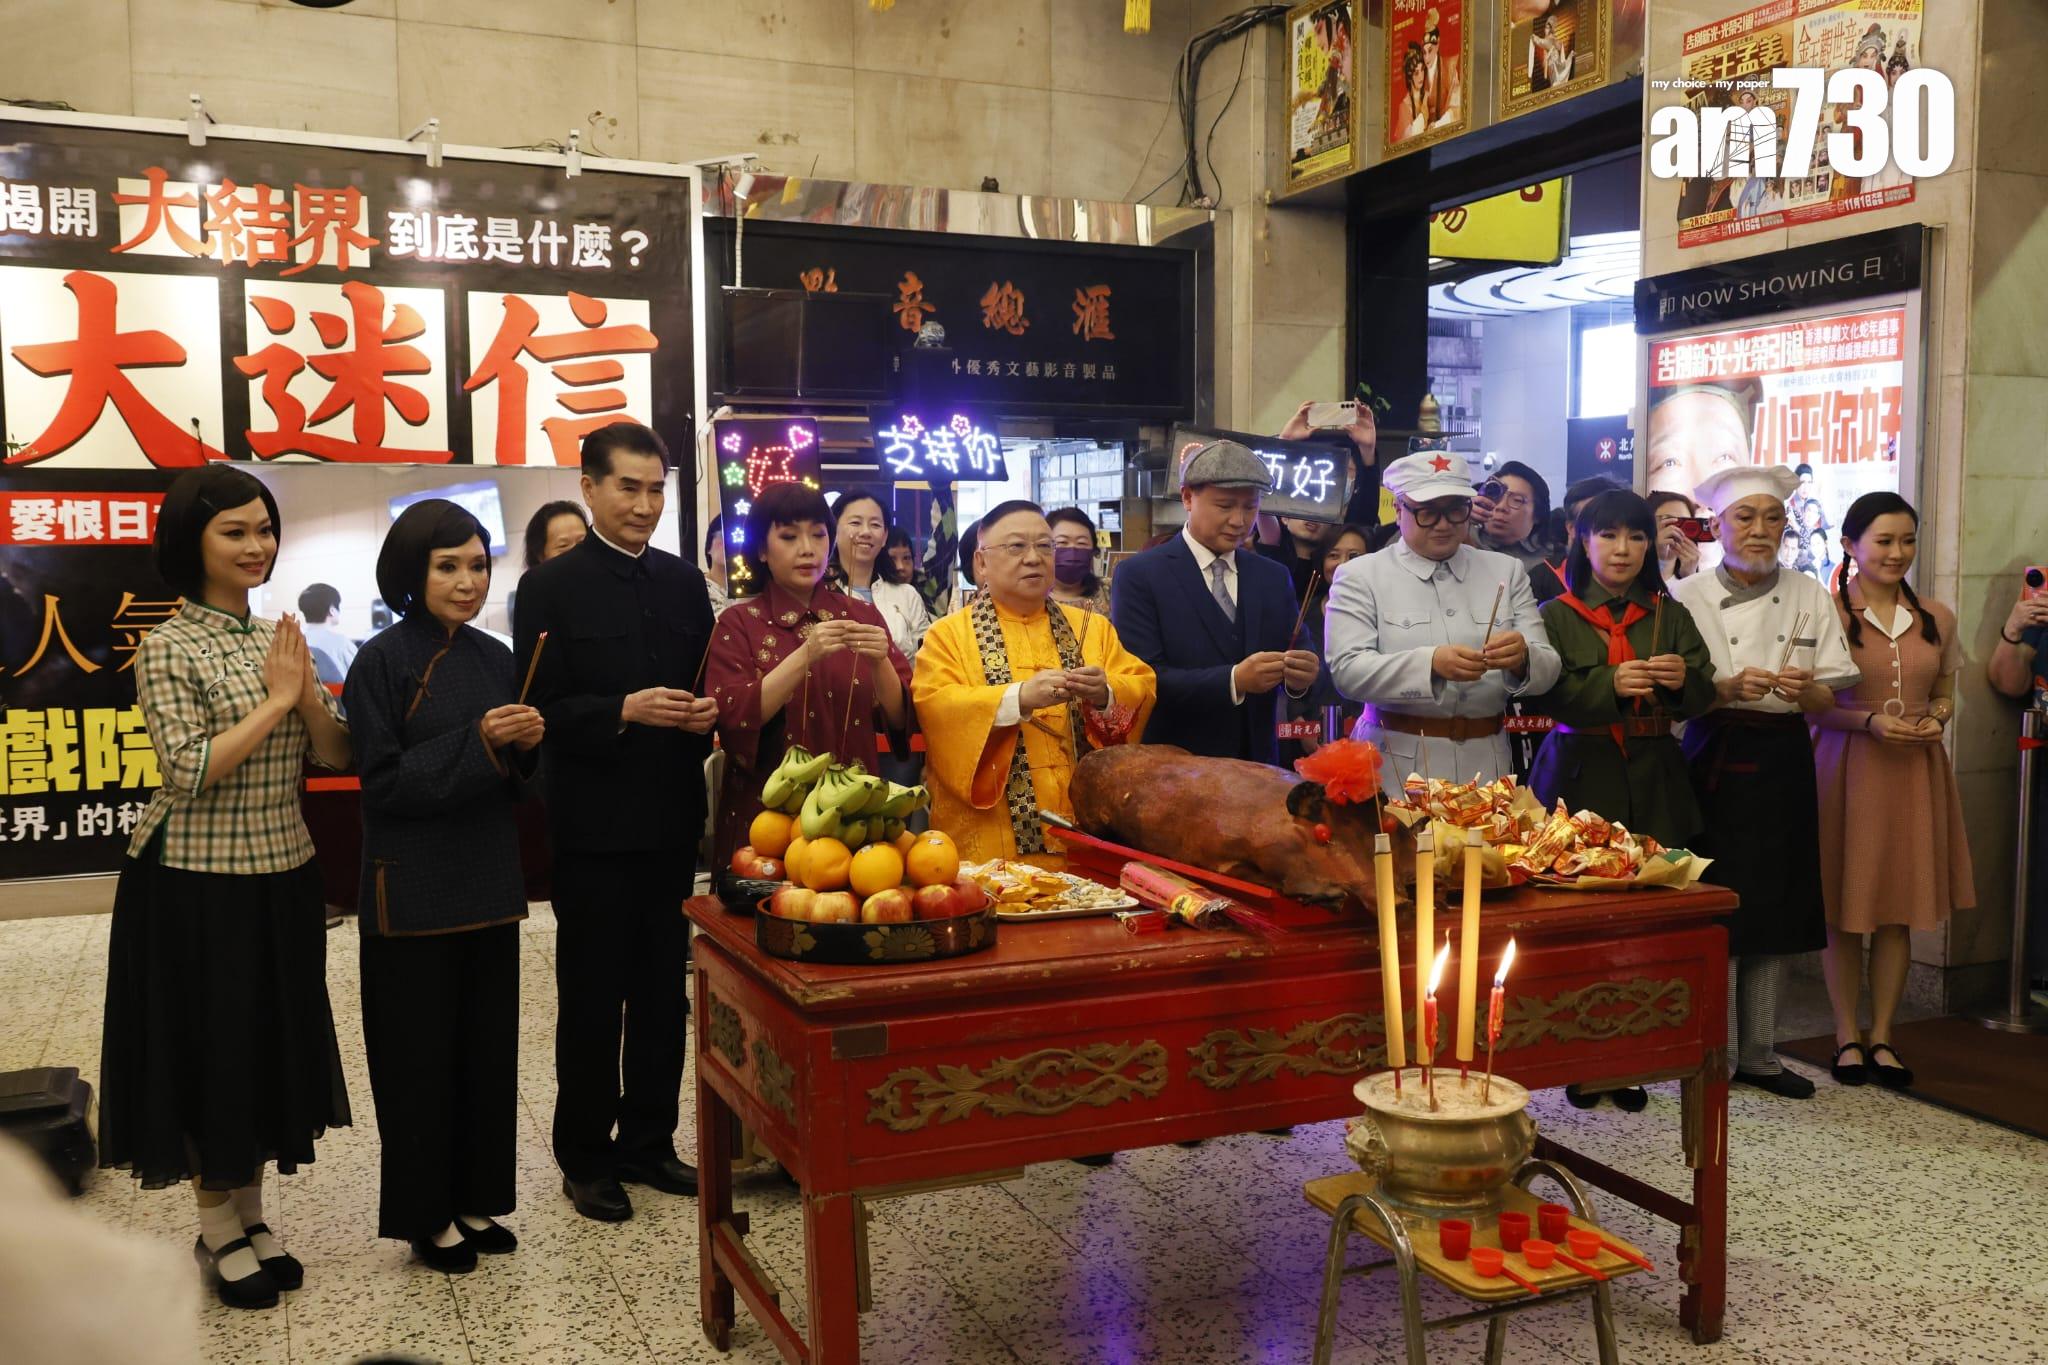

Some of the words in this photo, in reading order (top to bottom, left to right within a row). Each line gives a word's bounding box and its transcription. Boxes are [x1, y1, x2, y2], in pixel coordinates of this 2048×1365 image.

[0, 184, 98, 238] 揭開
[110, 166, 380, 276] 大結界
[1681, 286, 1734, 311] NOW
[1738, 262, 1854, 301] SHOWING
[3, 270, 659, 468] 大迷信
[878, 423, 1001, 475] 支持你
[1754, 386, 1903, 468] 小平你好
[10, 498, 161, 542] 愛恨日
